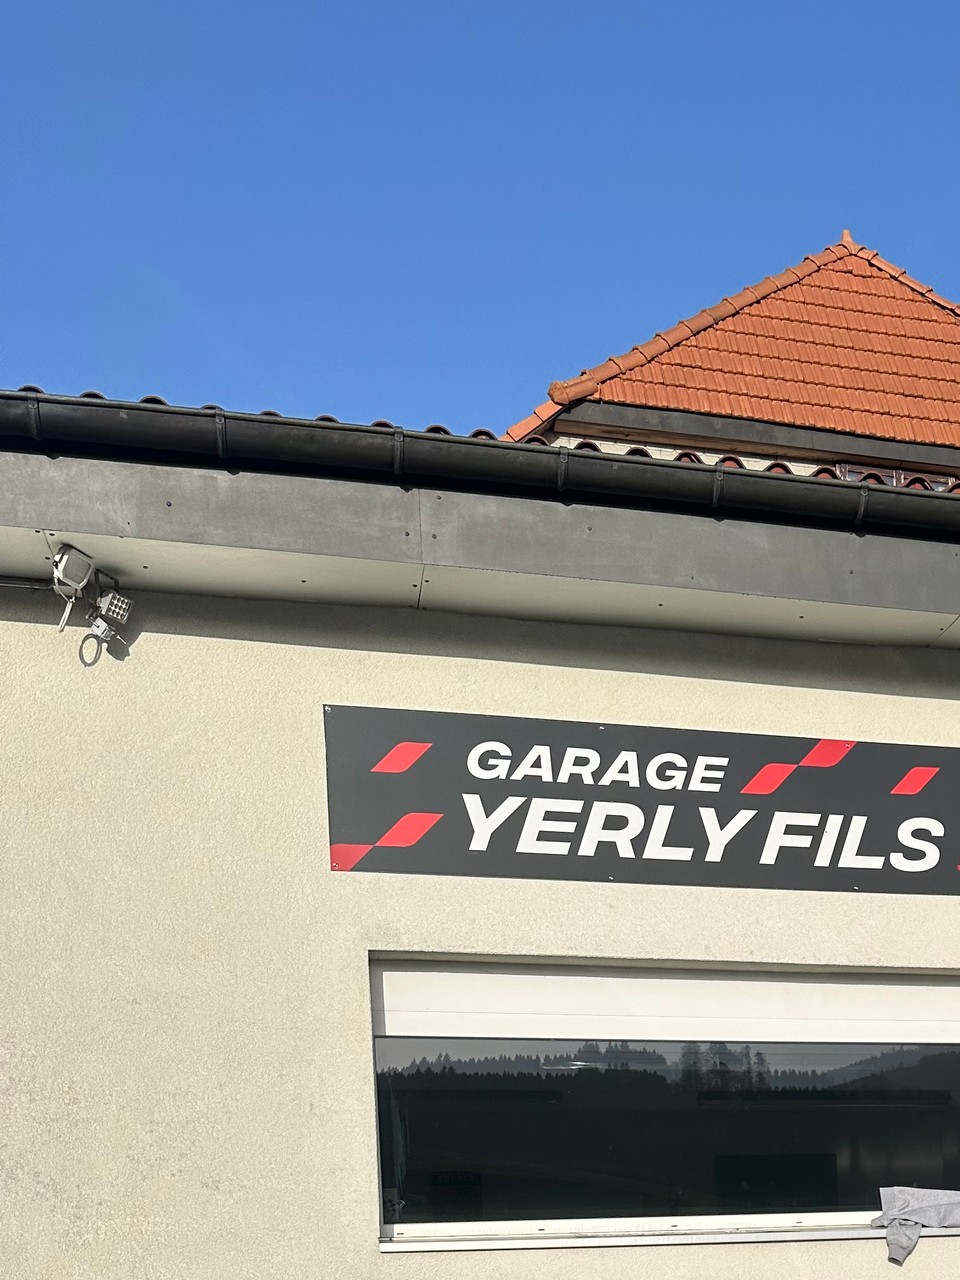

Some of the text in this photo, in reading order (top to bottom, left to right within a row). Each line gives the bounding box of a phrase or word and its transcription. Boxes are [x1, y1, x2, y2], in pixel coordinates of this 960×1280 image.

[466, 740, 730, 793] GARAGE
[461, 793, 759, 863] YERLY
[758, 811, 946, 873] FILS
